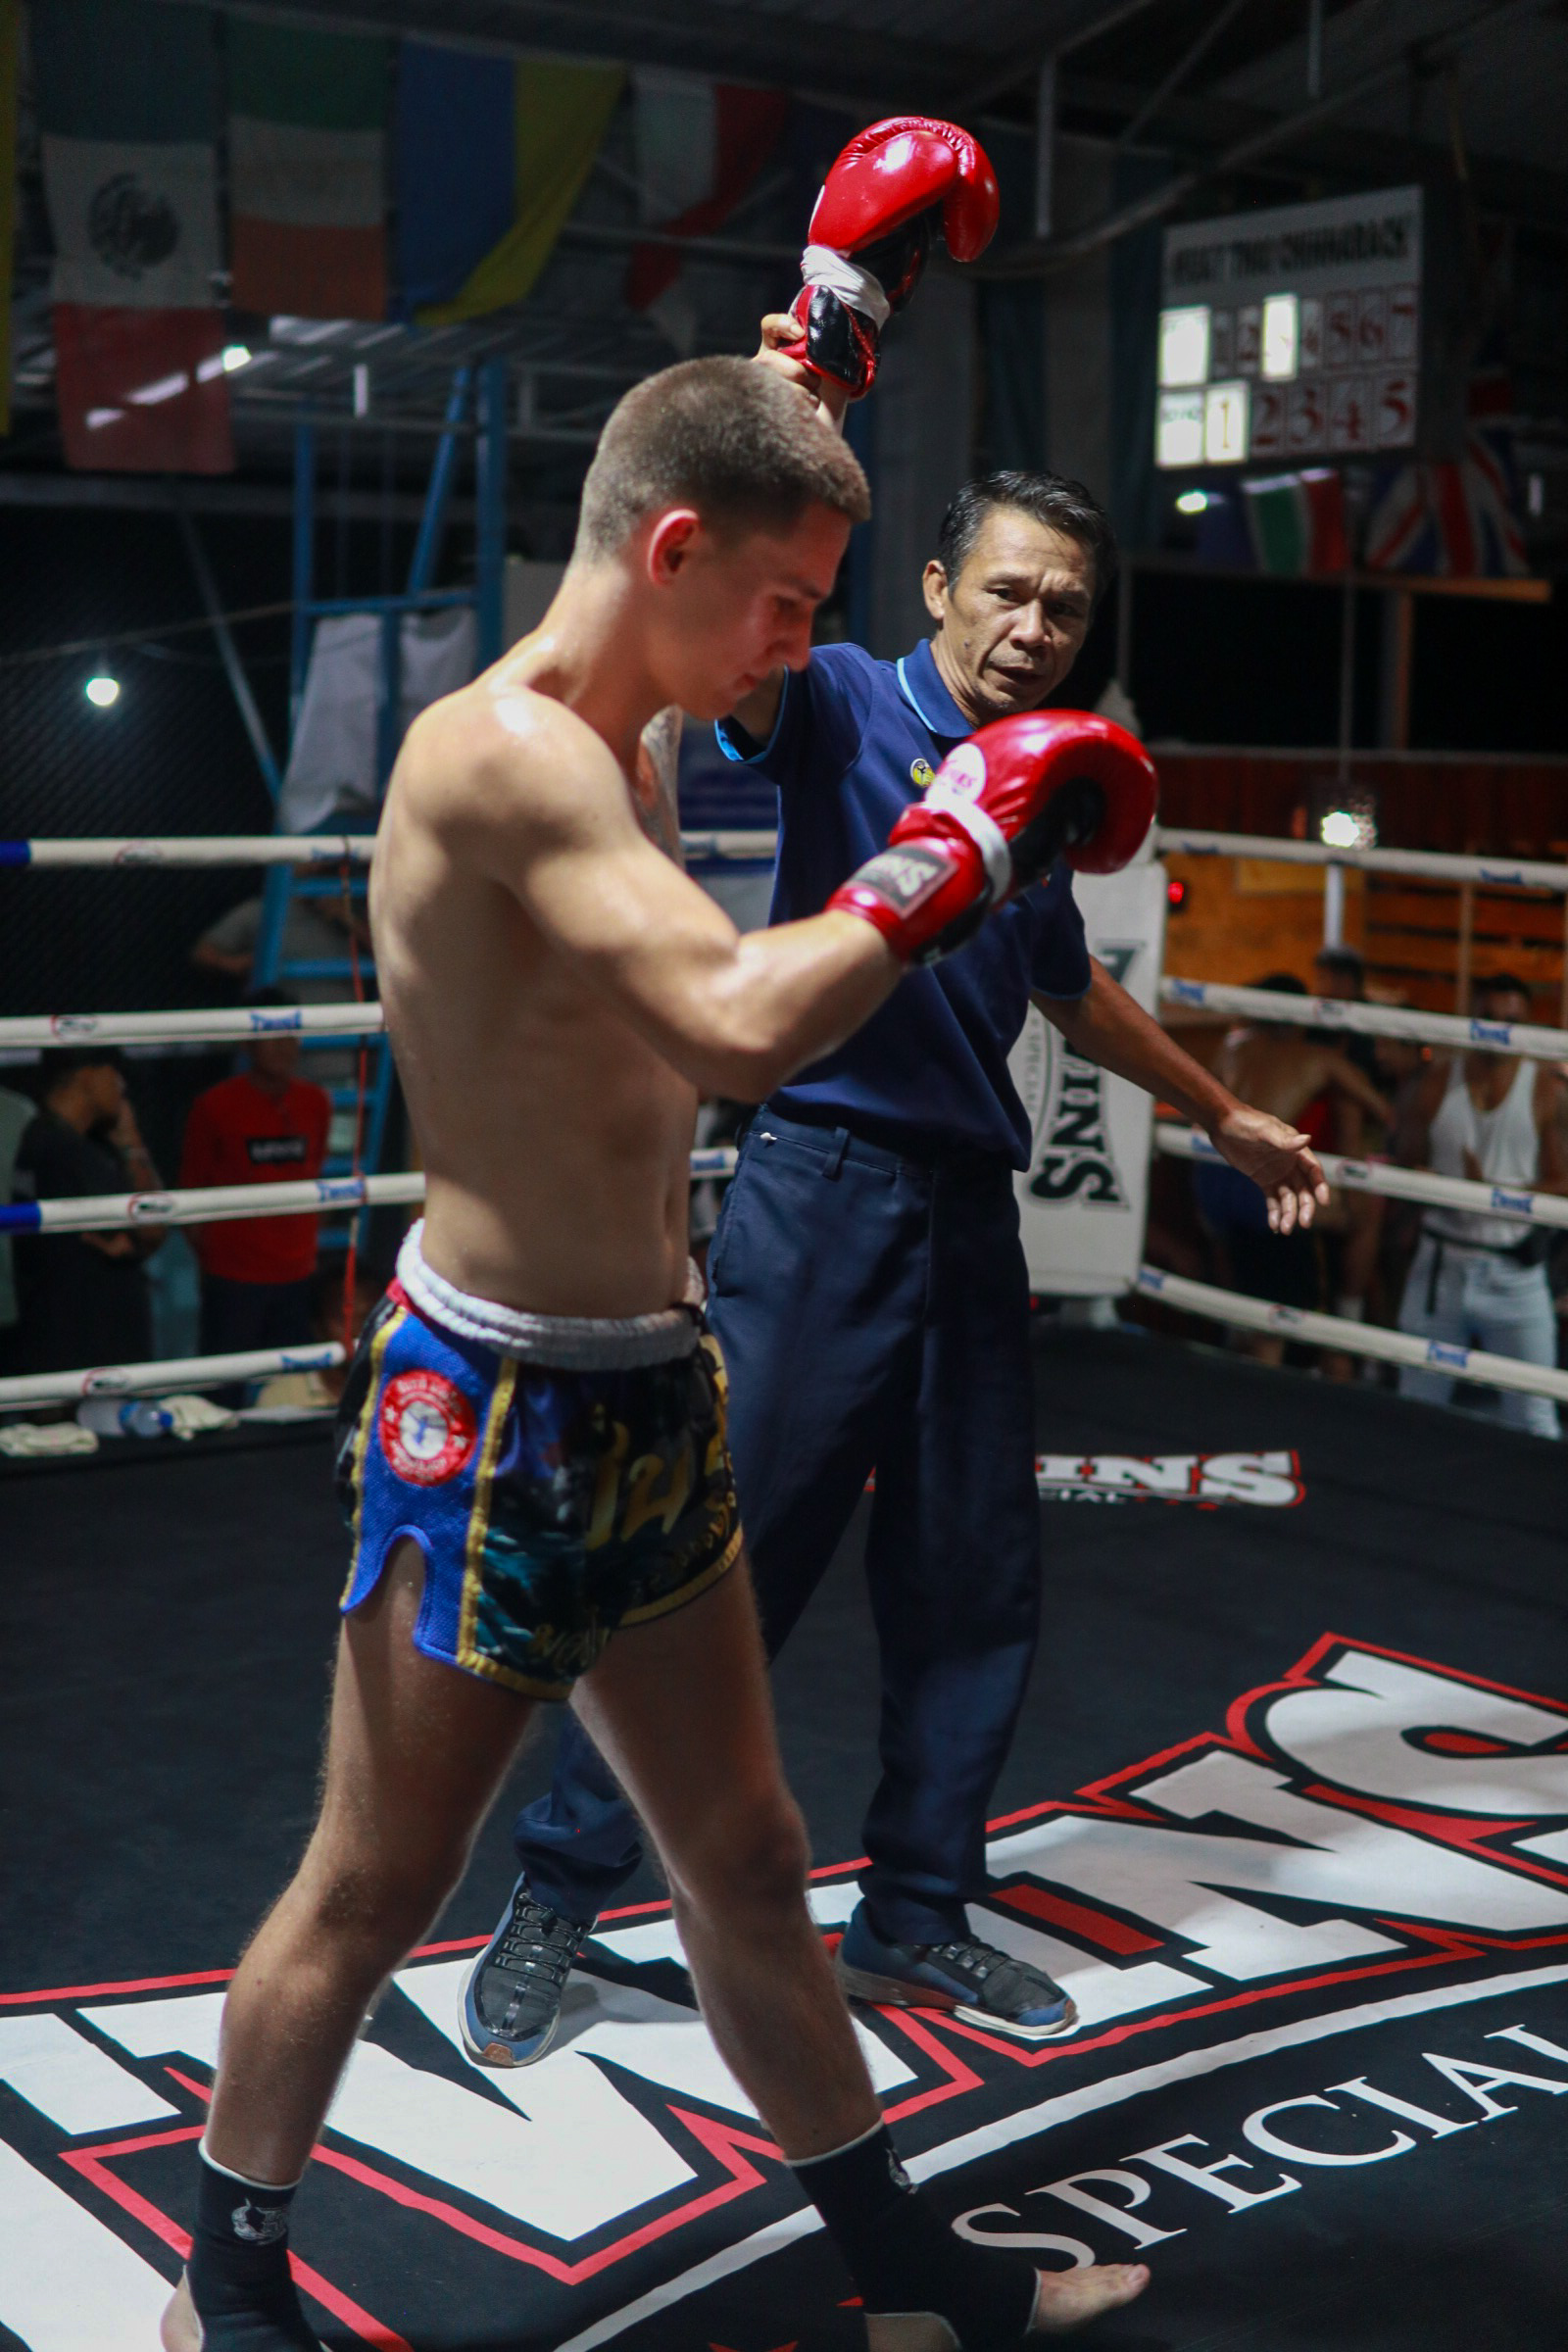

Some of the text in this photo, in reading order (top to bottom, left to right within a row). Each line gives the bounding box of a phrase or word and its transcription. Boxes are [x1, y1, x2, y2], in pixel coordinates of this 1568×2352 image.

[1254, 394, 1279, 446] 2
[1290, 388, 1323, 444] 3
[1333, 394, 1362, 441] 4
[1382, 379, 1412, 436] 5
[1033, 1450, 1298, 1507] INS
